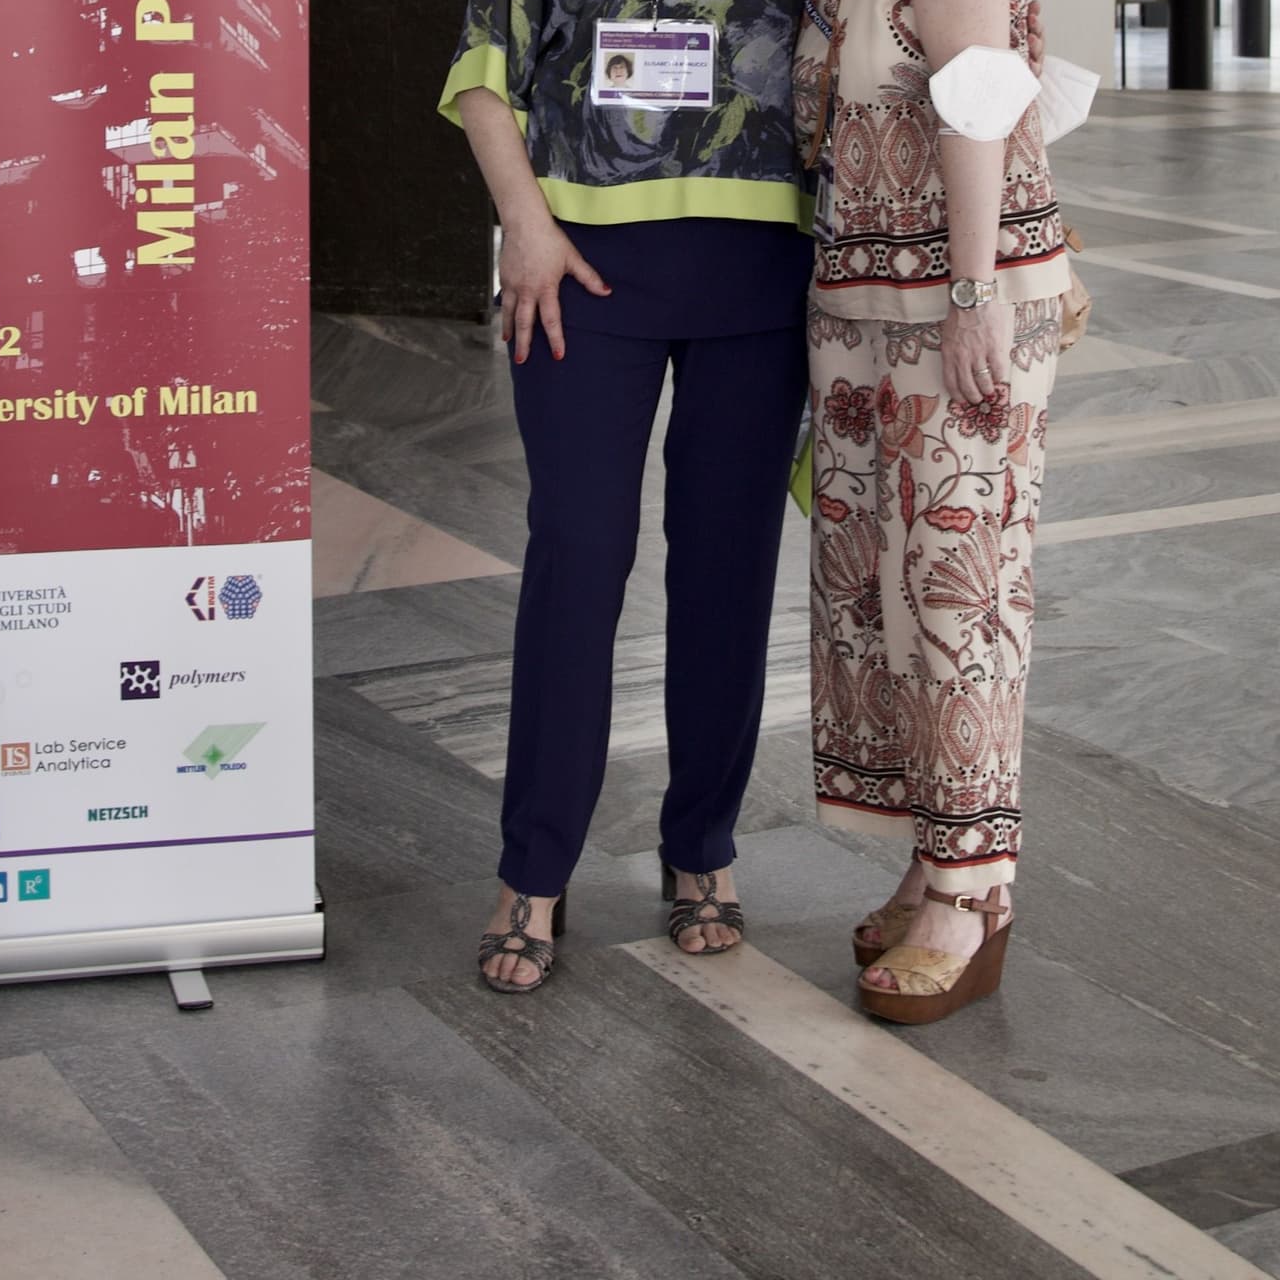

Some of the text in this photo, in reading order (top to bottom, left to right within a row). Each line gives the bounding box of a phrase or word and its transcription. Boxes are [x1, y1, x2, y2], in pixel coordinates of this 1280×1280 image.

[135, 72, 196, 266] Milan
[111, 387, 147, 418] of
[159, 386, 257, 418] Milan
[27, 602, 72, 615] STUDI
[0, 617, 59, 631] MILANO
[169, 669, 246, 689] polymers
[35, 737, 127, 755] Lab Service
[34, 756, 111, 773] Analytica
[176, 762, 247, 773] METTLER TOLEDO
[88, 805, 148, 822] NETZSCH
